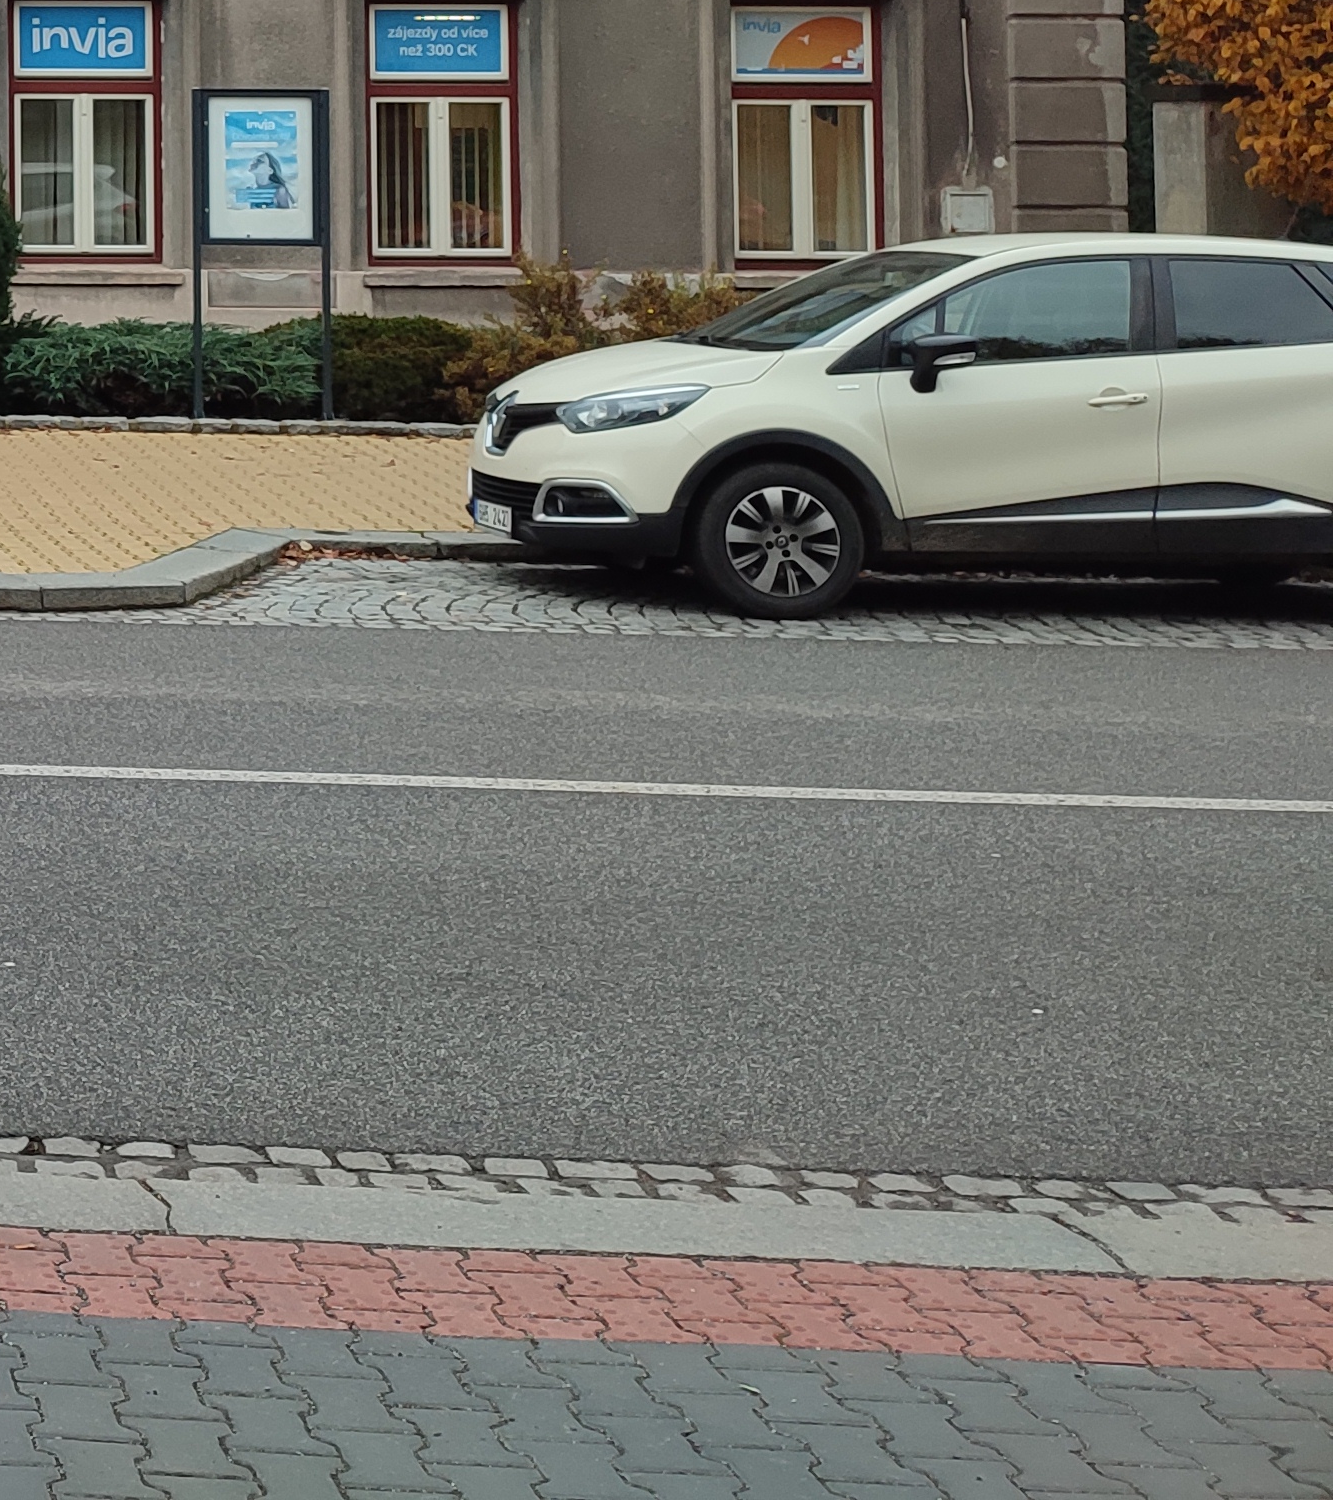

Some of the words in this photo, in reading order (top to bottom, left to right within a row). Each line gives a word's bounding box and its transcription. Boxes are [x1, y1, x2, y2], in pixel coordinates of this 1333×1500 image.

[387, 26, 438, 41] zájezdy
[441, 26, 458, 38] od
[461, 26, 489, 38] více
[742, 18, 782, 34] invia
[31, 17, 134, 58] invia
[399, 44, 424, 56] než
[426, 44, 454, 56] 300
[457, 44, 478, 56] CK
[246, 119, 276, 131] invia
